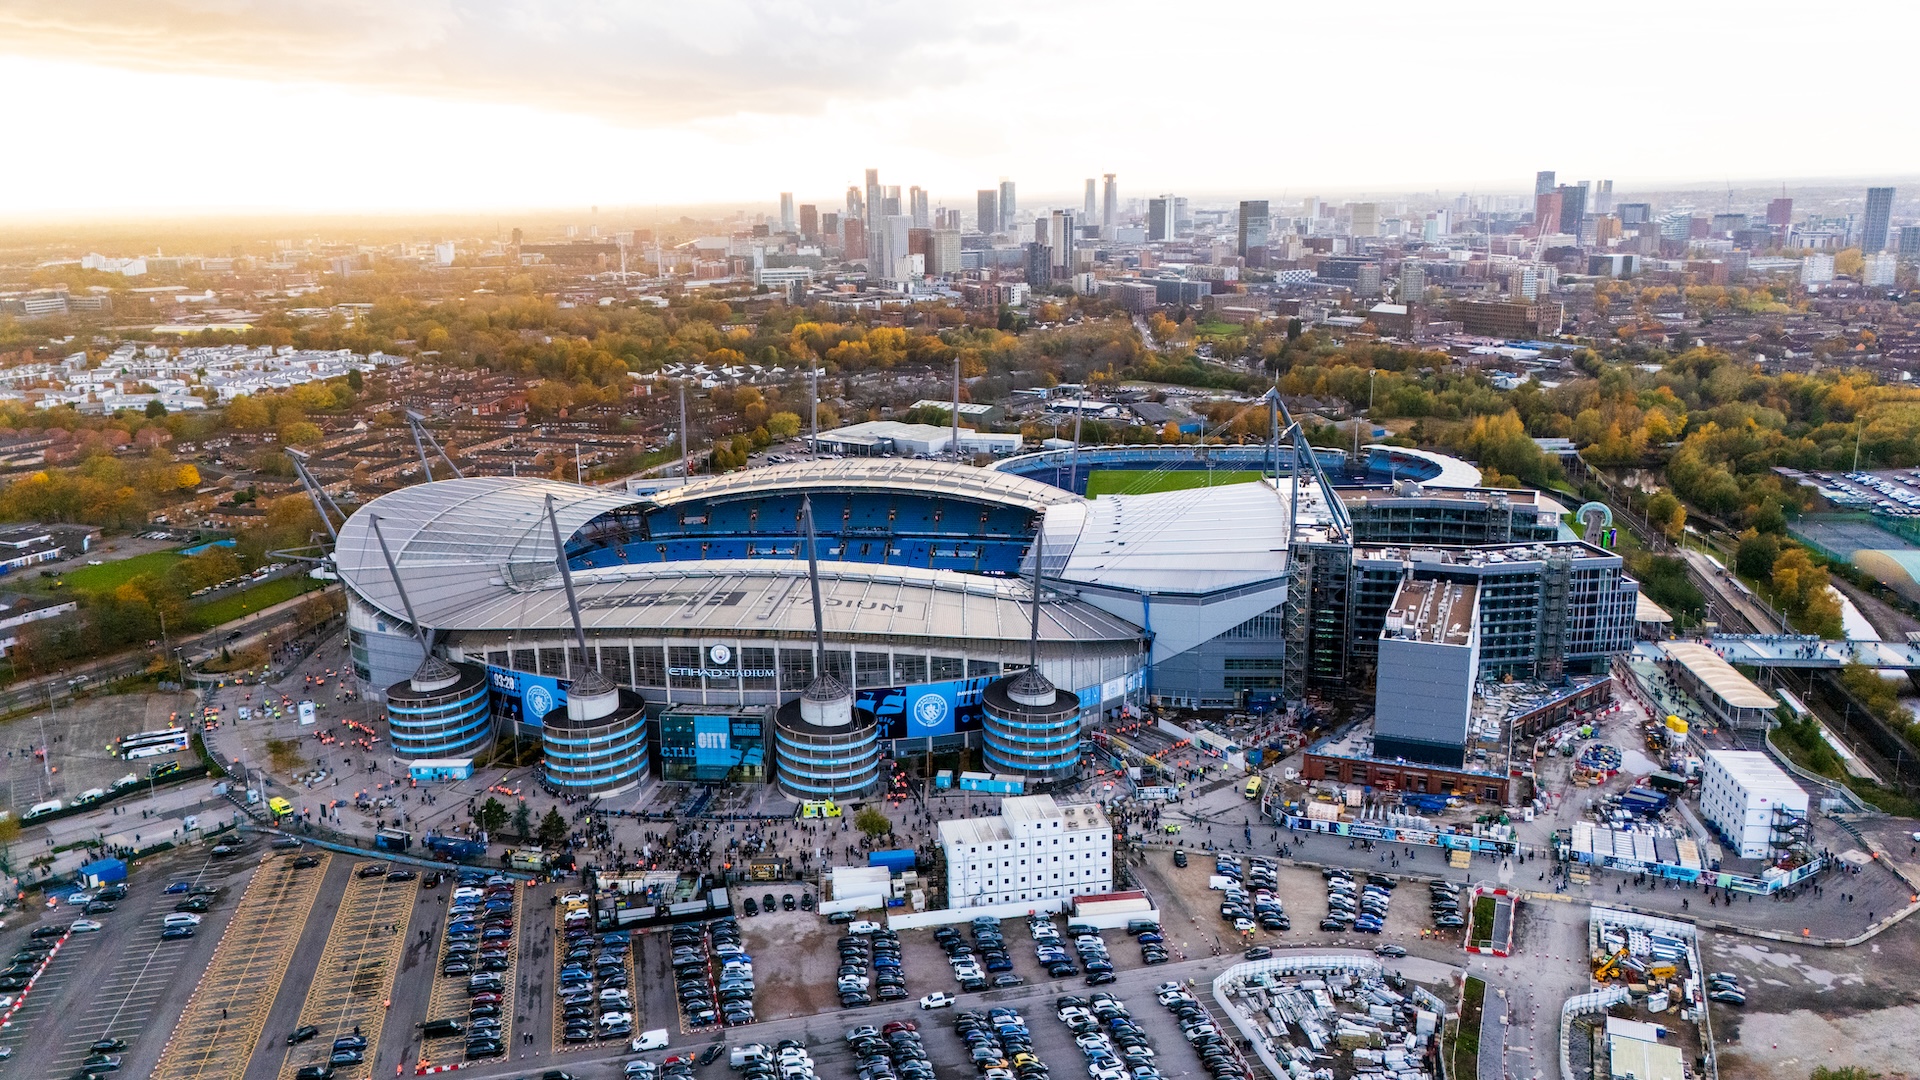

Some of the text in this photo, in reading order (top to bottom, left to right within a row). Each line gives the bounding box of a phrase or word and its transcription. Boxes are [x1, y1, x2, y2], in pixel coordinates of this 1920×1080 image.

[668, 667, 775, 677] ETIHAD STADIUM
[697, 732, 728, 749] CITY
